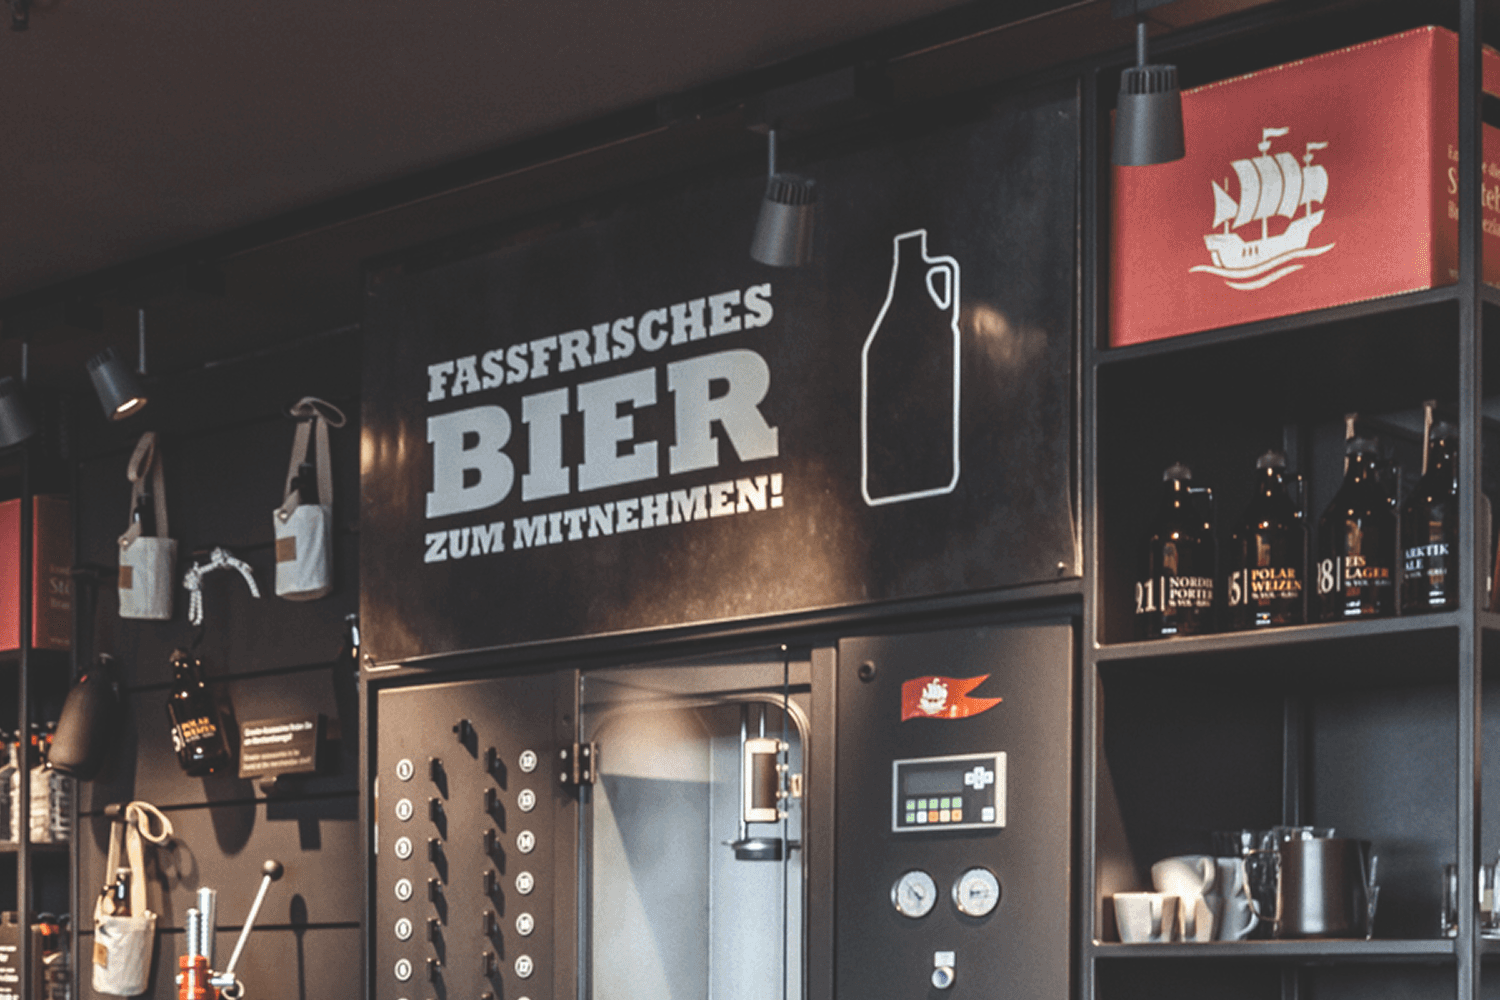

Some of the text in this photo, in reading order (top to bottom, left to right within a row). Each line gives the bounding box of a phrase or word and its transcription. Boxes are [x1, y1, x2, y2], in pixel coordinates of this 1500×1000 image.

[427, 283, 773, 402] FASSFRISCHES
[426, 349, 779, 519] BIER
[424, 472, 785, 563] ZUM MITNEHMEN!
[1251, 568, 1295, 580] POLAR
